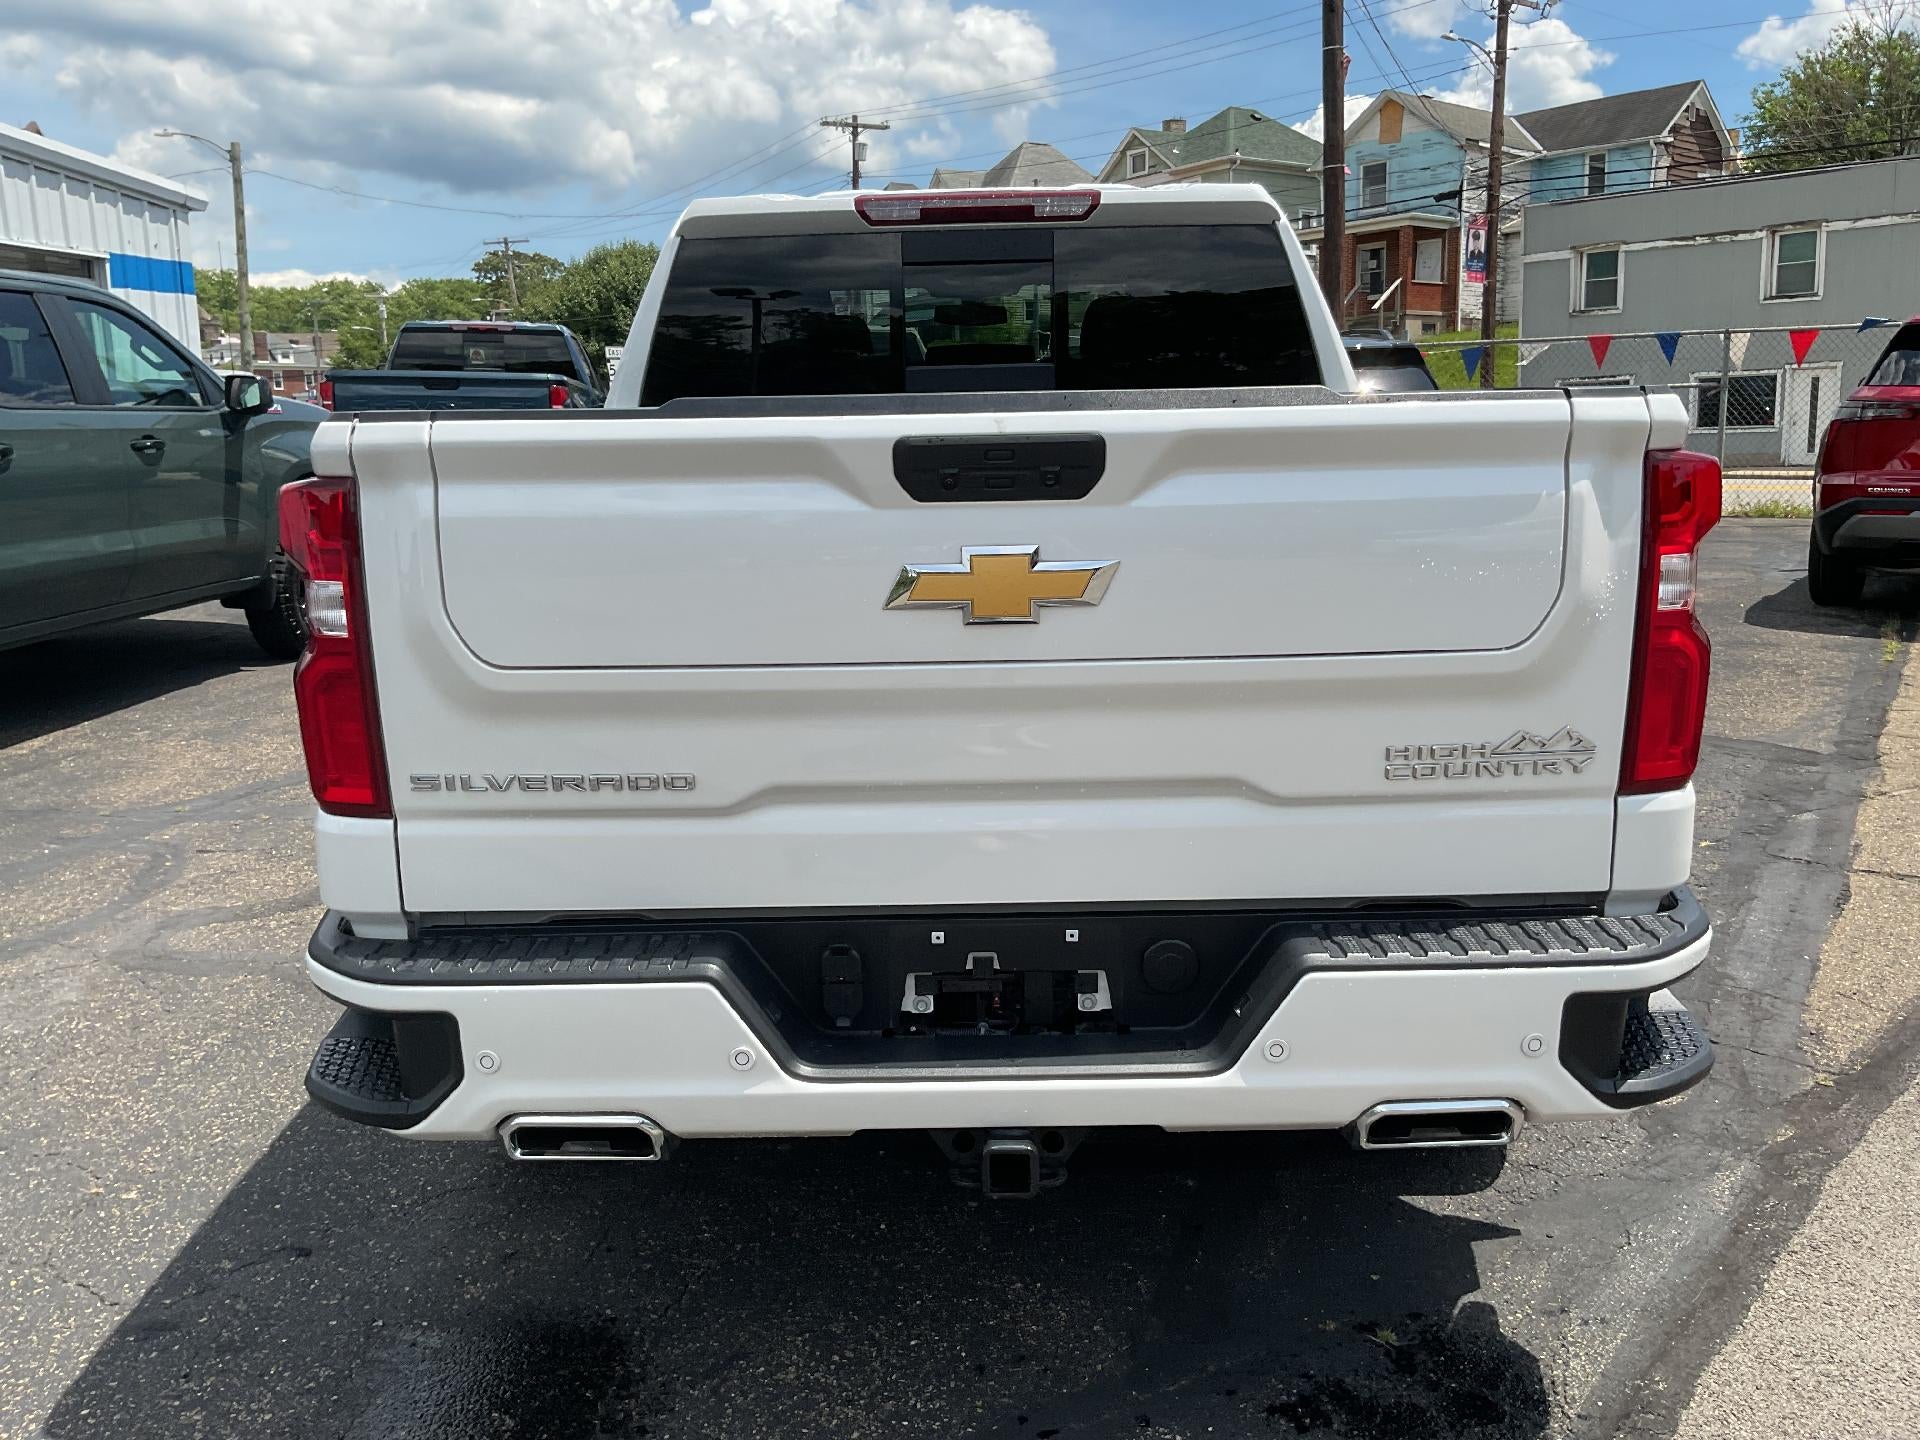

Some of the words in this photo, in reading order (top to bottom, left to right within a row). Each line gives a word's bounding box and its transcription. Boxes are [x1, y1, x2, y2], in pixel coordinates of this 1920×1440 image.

[1385, 743, 1492, 761] HIGH
[1384, 757, 1594, 780] COUNTRY
[409, 773, 696, 792] SILVERADO
